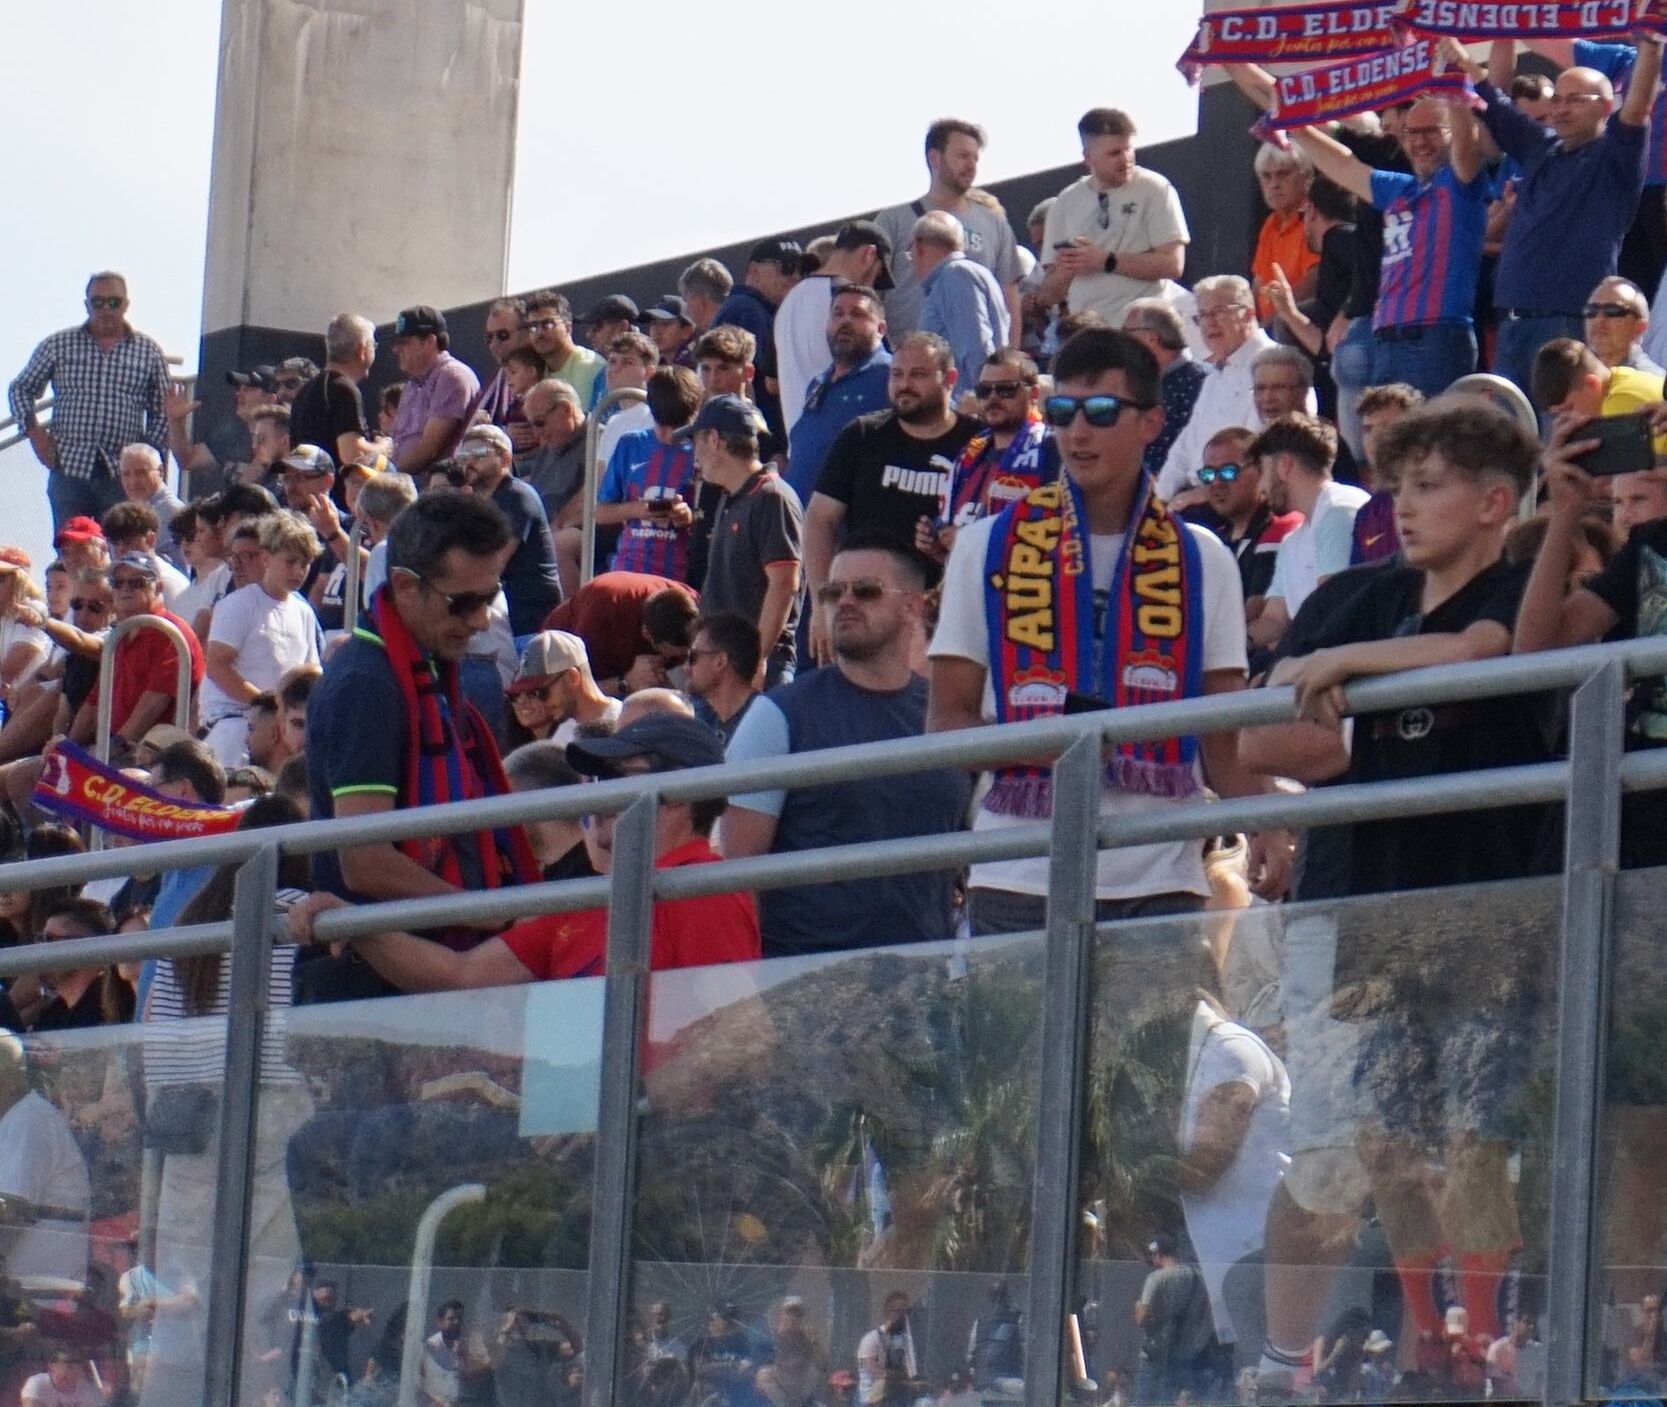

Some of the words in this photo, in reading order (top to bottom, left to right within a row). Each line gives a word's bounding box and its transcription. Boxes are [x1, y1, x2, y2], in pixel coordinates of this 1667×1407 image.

[1221, 15, 1287, 41] C.D.
[1279, 76, 1322, 105] C.D.
[1329, 40, 1429, 94] ELDENSE
[882, 464, 949, 495] PUM
[991, 518, 1062, 652] AÚPA
